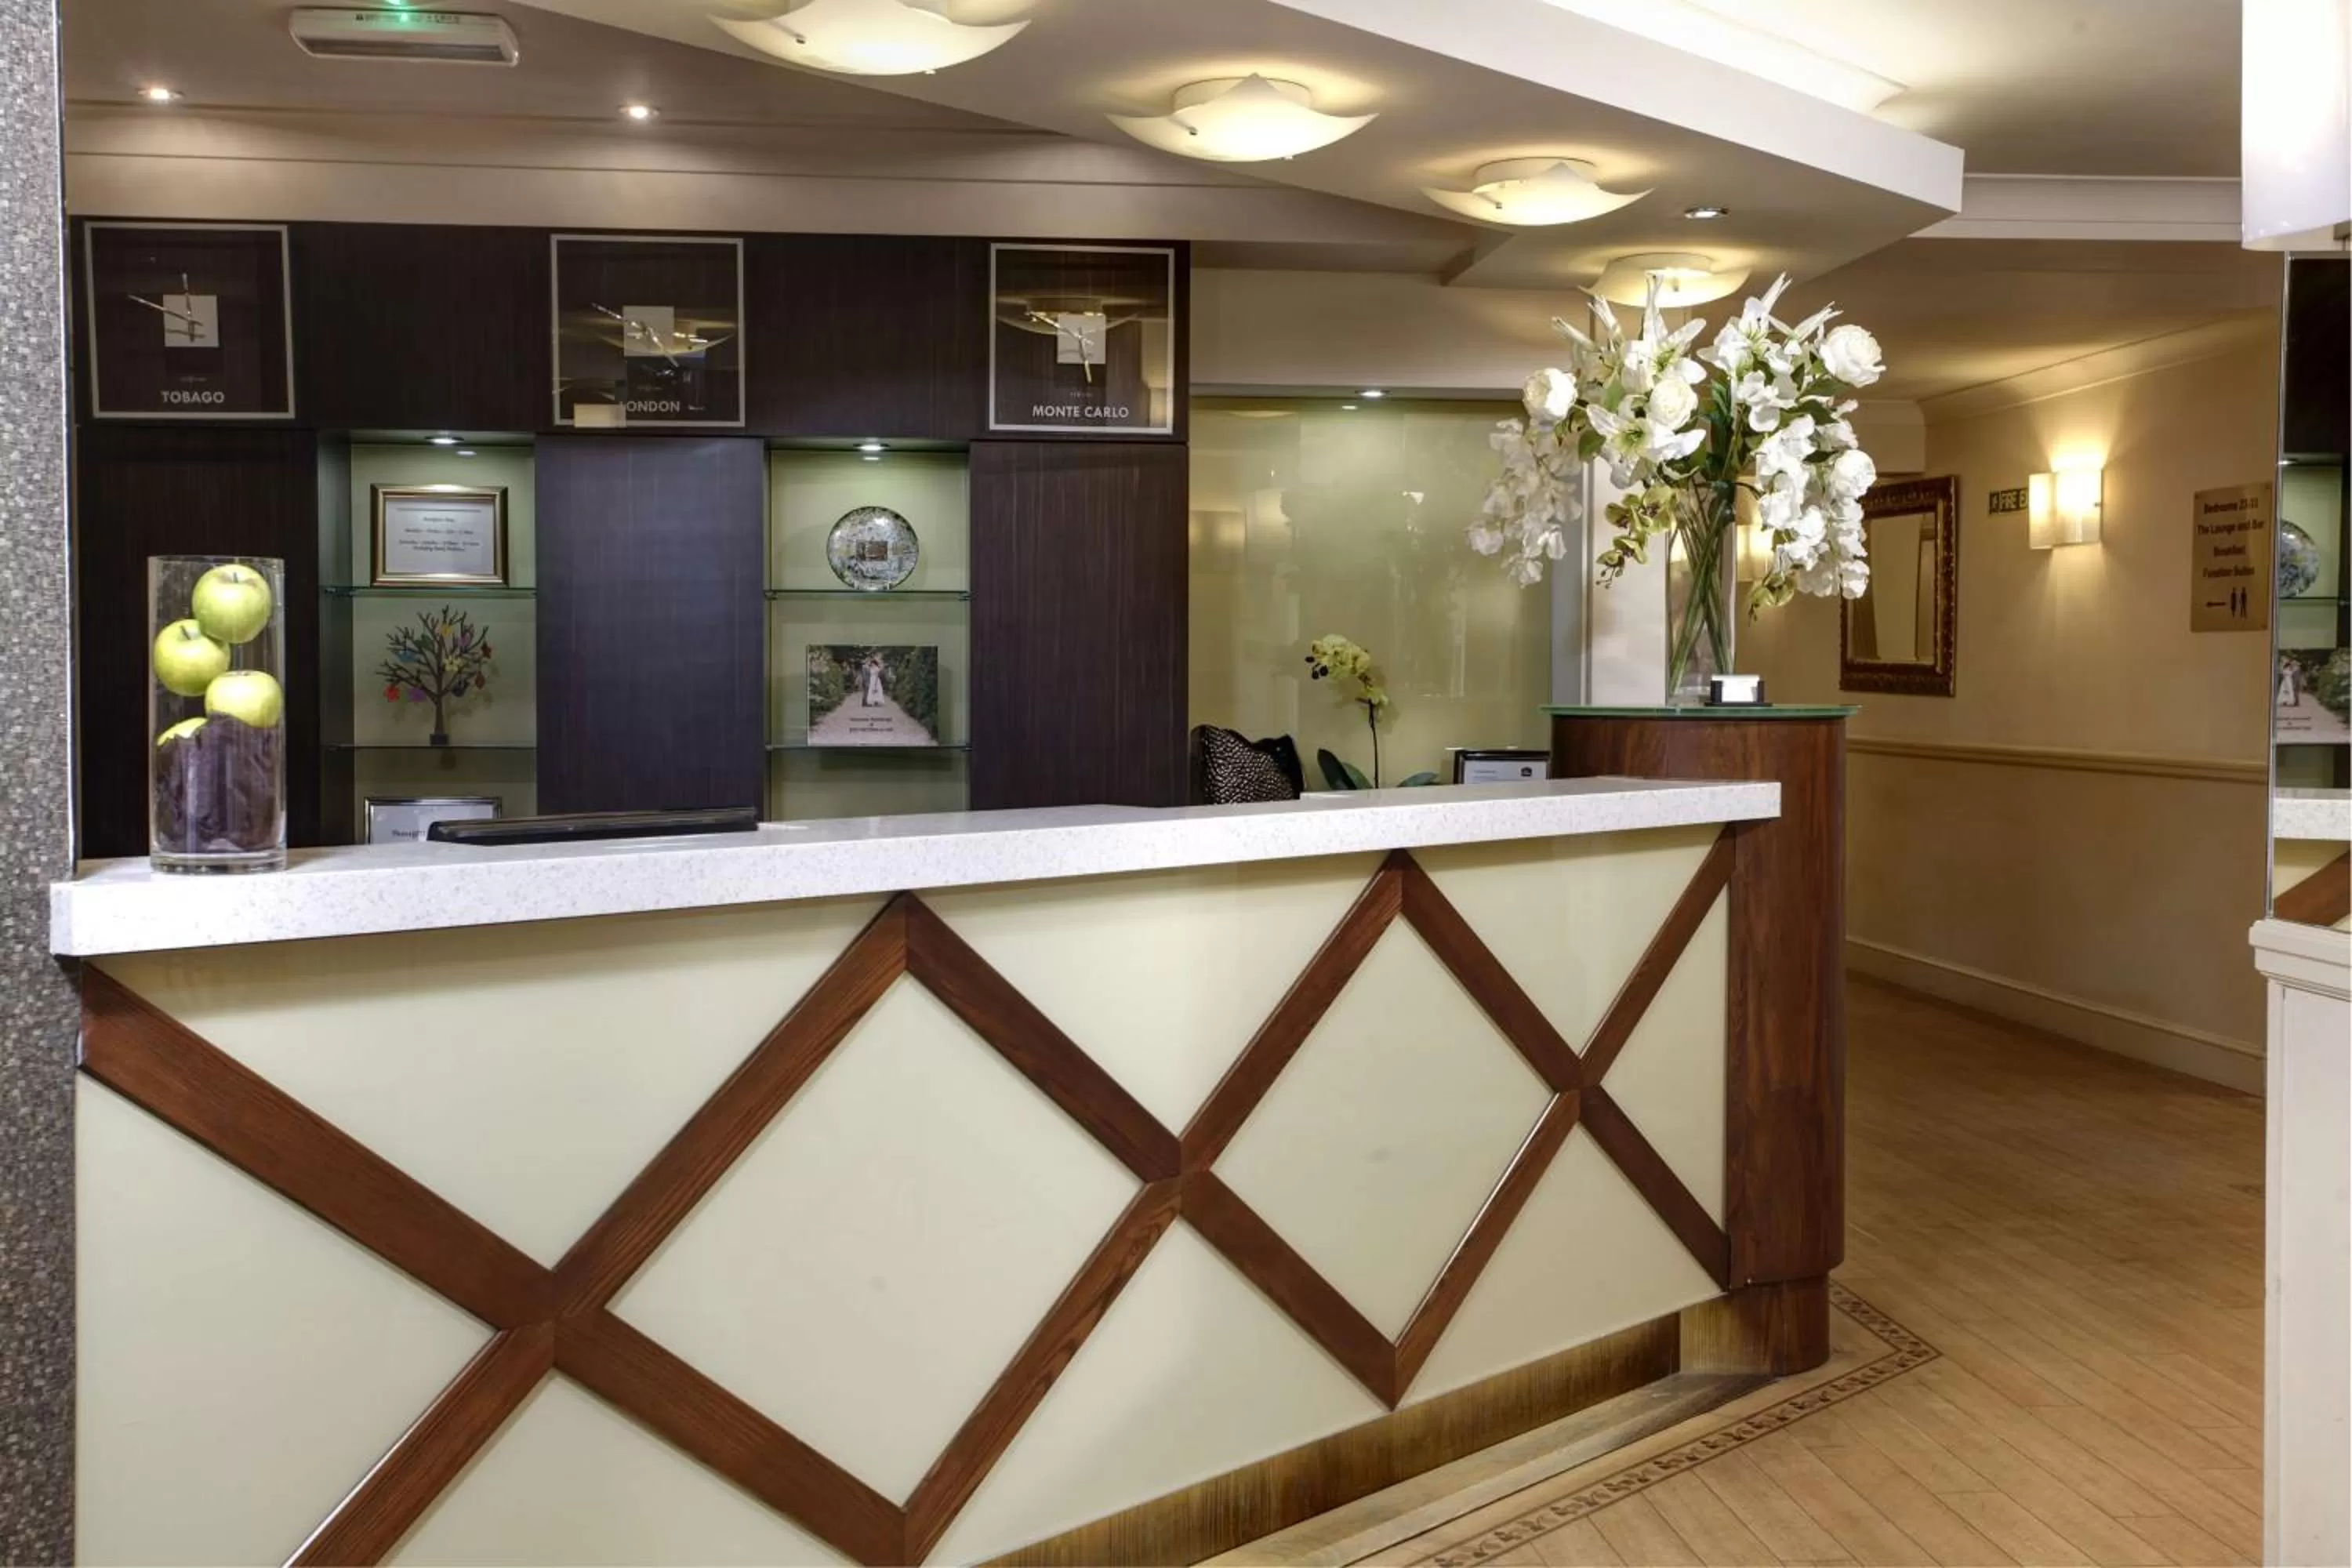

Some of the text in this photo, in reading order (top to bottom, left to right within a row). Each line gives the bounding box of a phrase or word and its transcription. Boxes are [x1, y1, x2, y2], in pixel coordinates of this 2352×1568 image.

[160, 390, 225, 405] TOBAGO
[1032, 405, 1130, 418] MONTE CARLO
